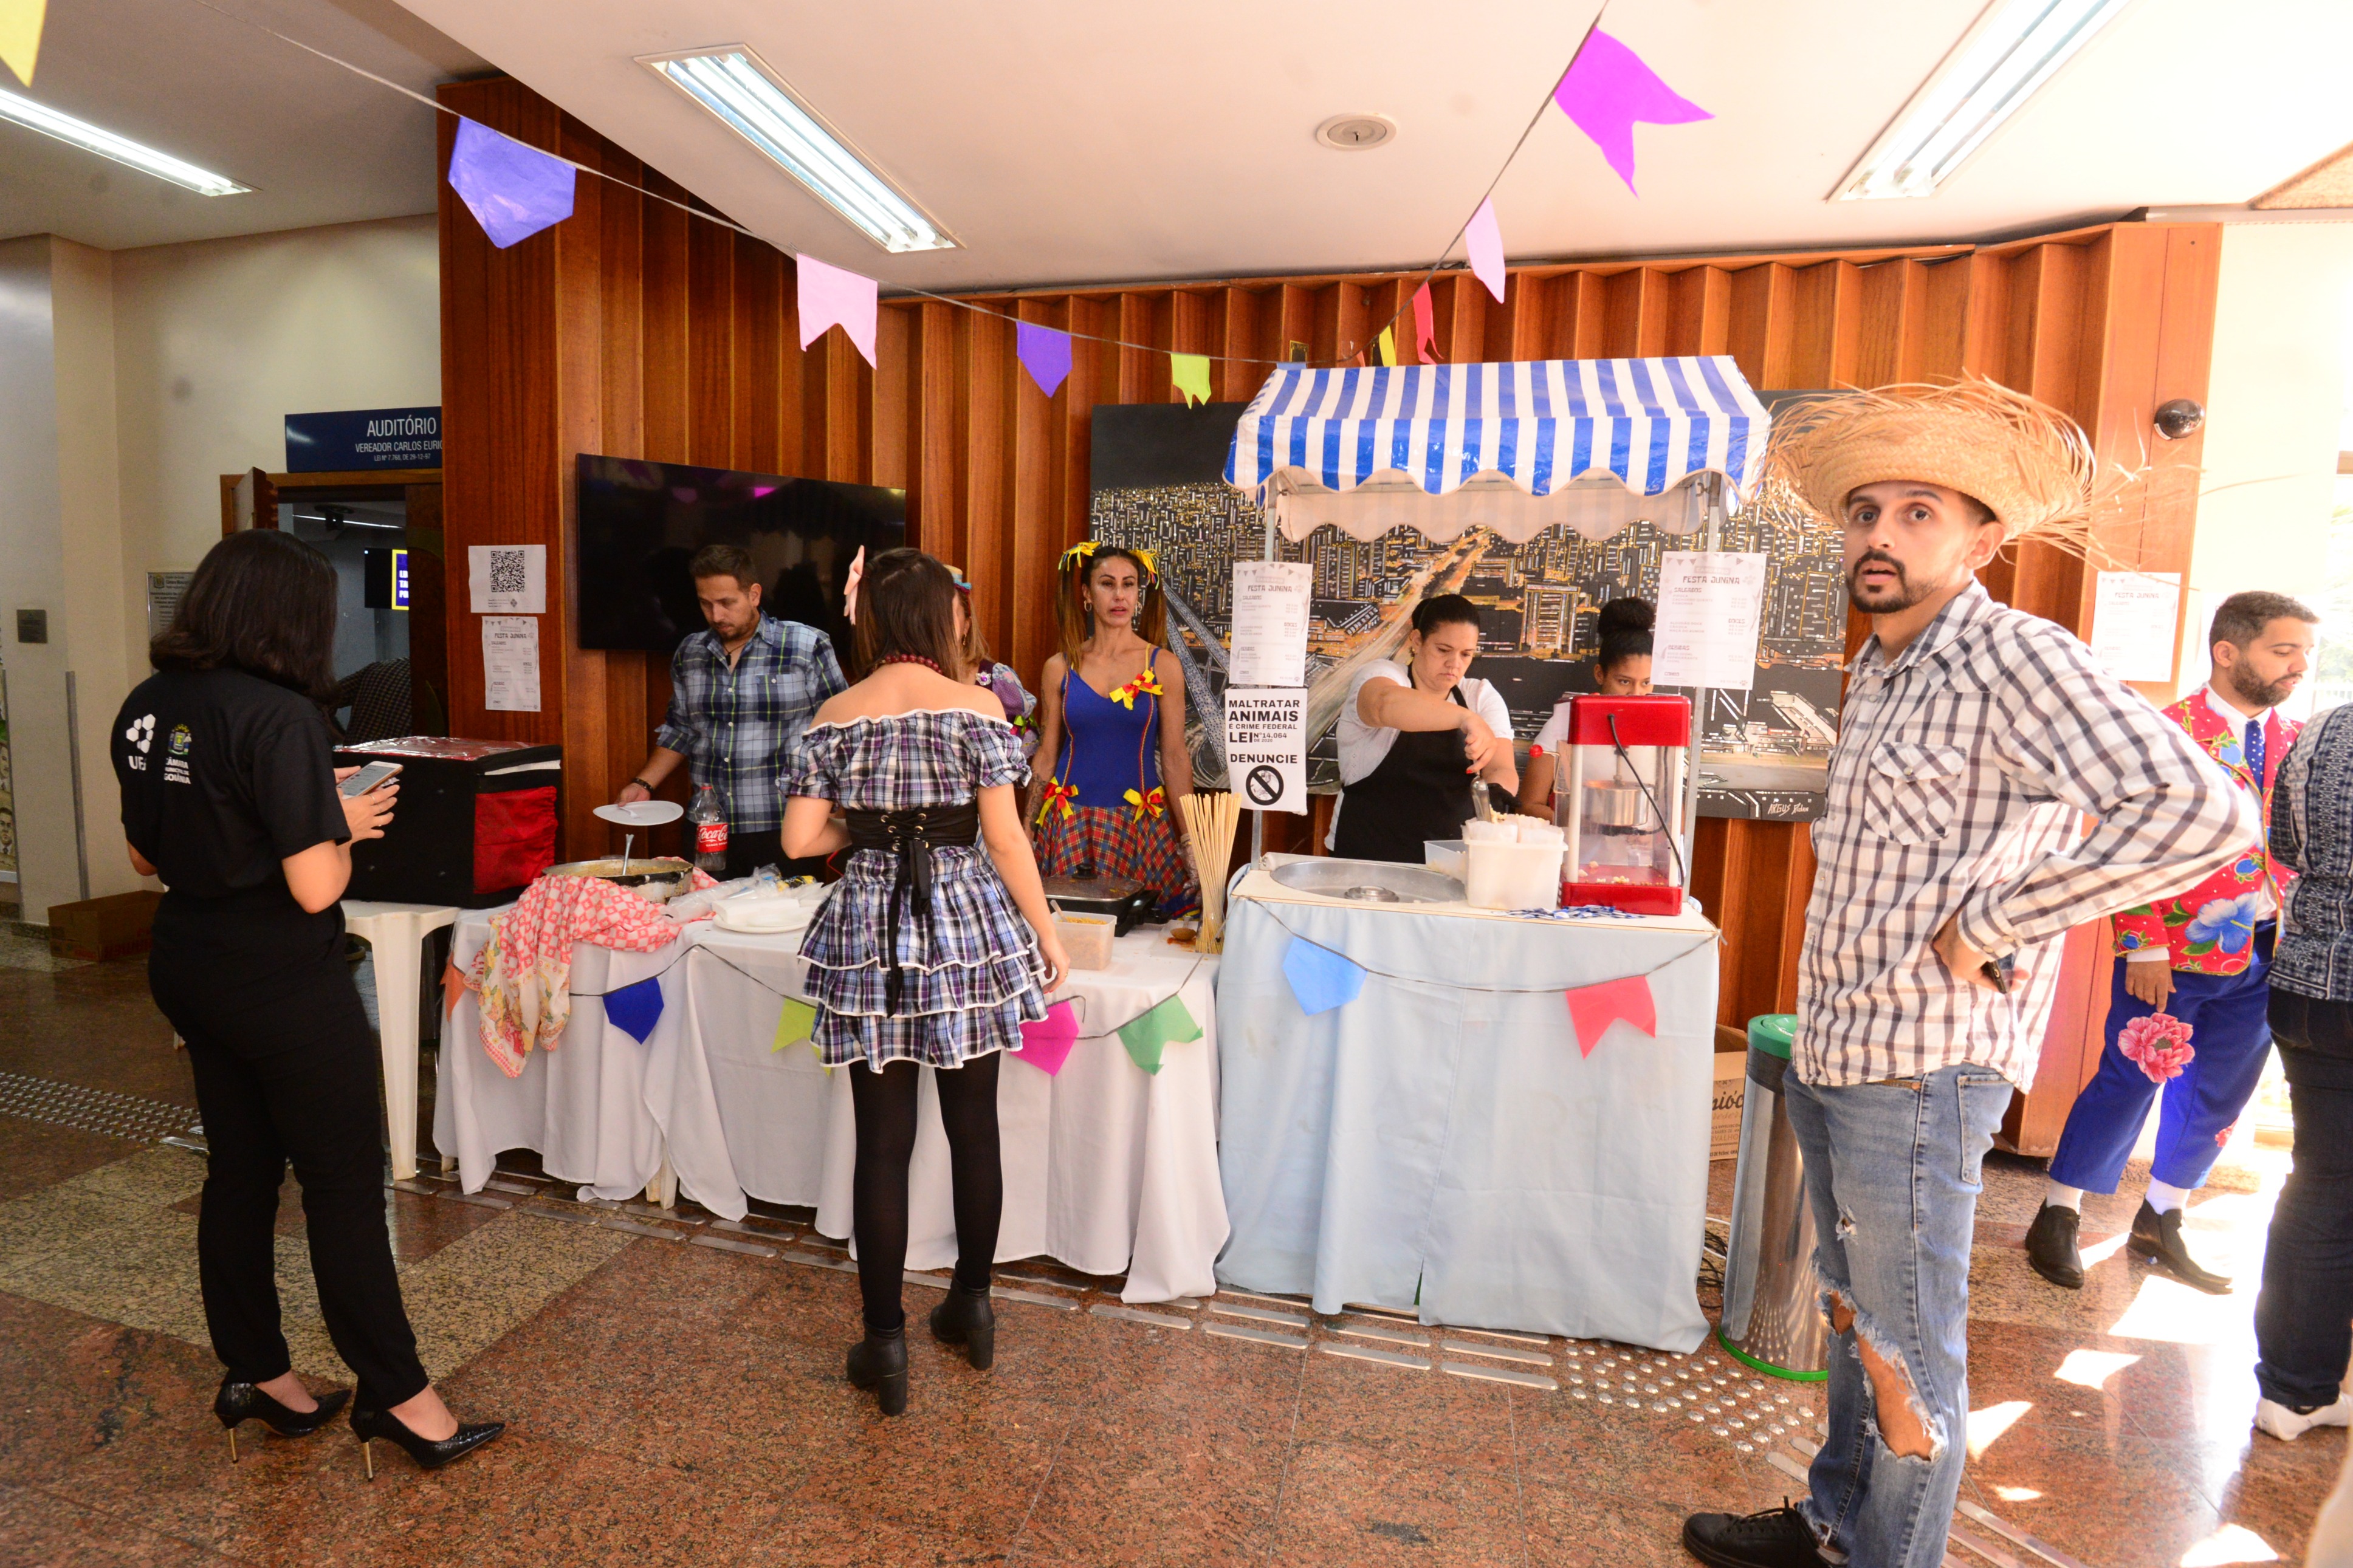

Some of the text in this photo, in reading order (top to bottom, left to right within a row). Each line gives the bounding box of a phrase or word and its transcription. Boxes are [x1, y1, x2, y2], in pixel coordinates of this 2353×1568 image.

[366, 414, 436, 437] AUDITÓRIO
[356, 442, 392, 453] VEREADOR
[393, 441, 422, 451] CARLOS
[1229, 711, 1299, 722] ANIMAIS
[1229, 732, 1253, 743] LEI
[1231, 754, 1297, 764] DENUNCIE
